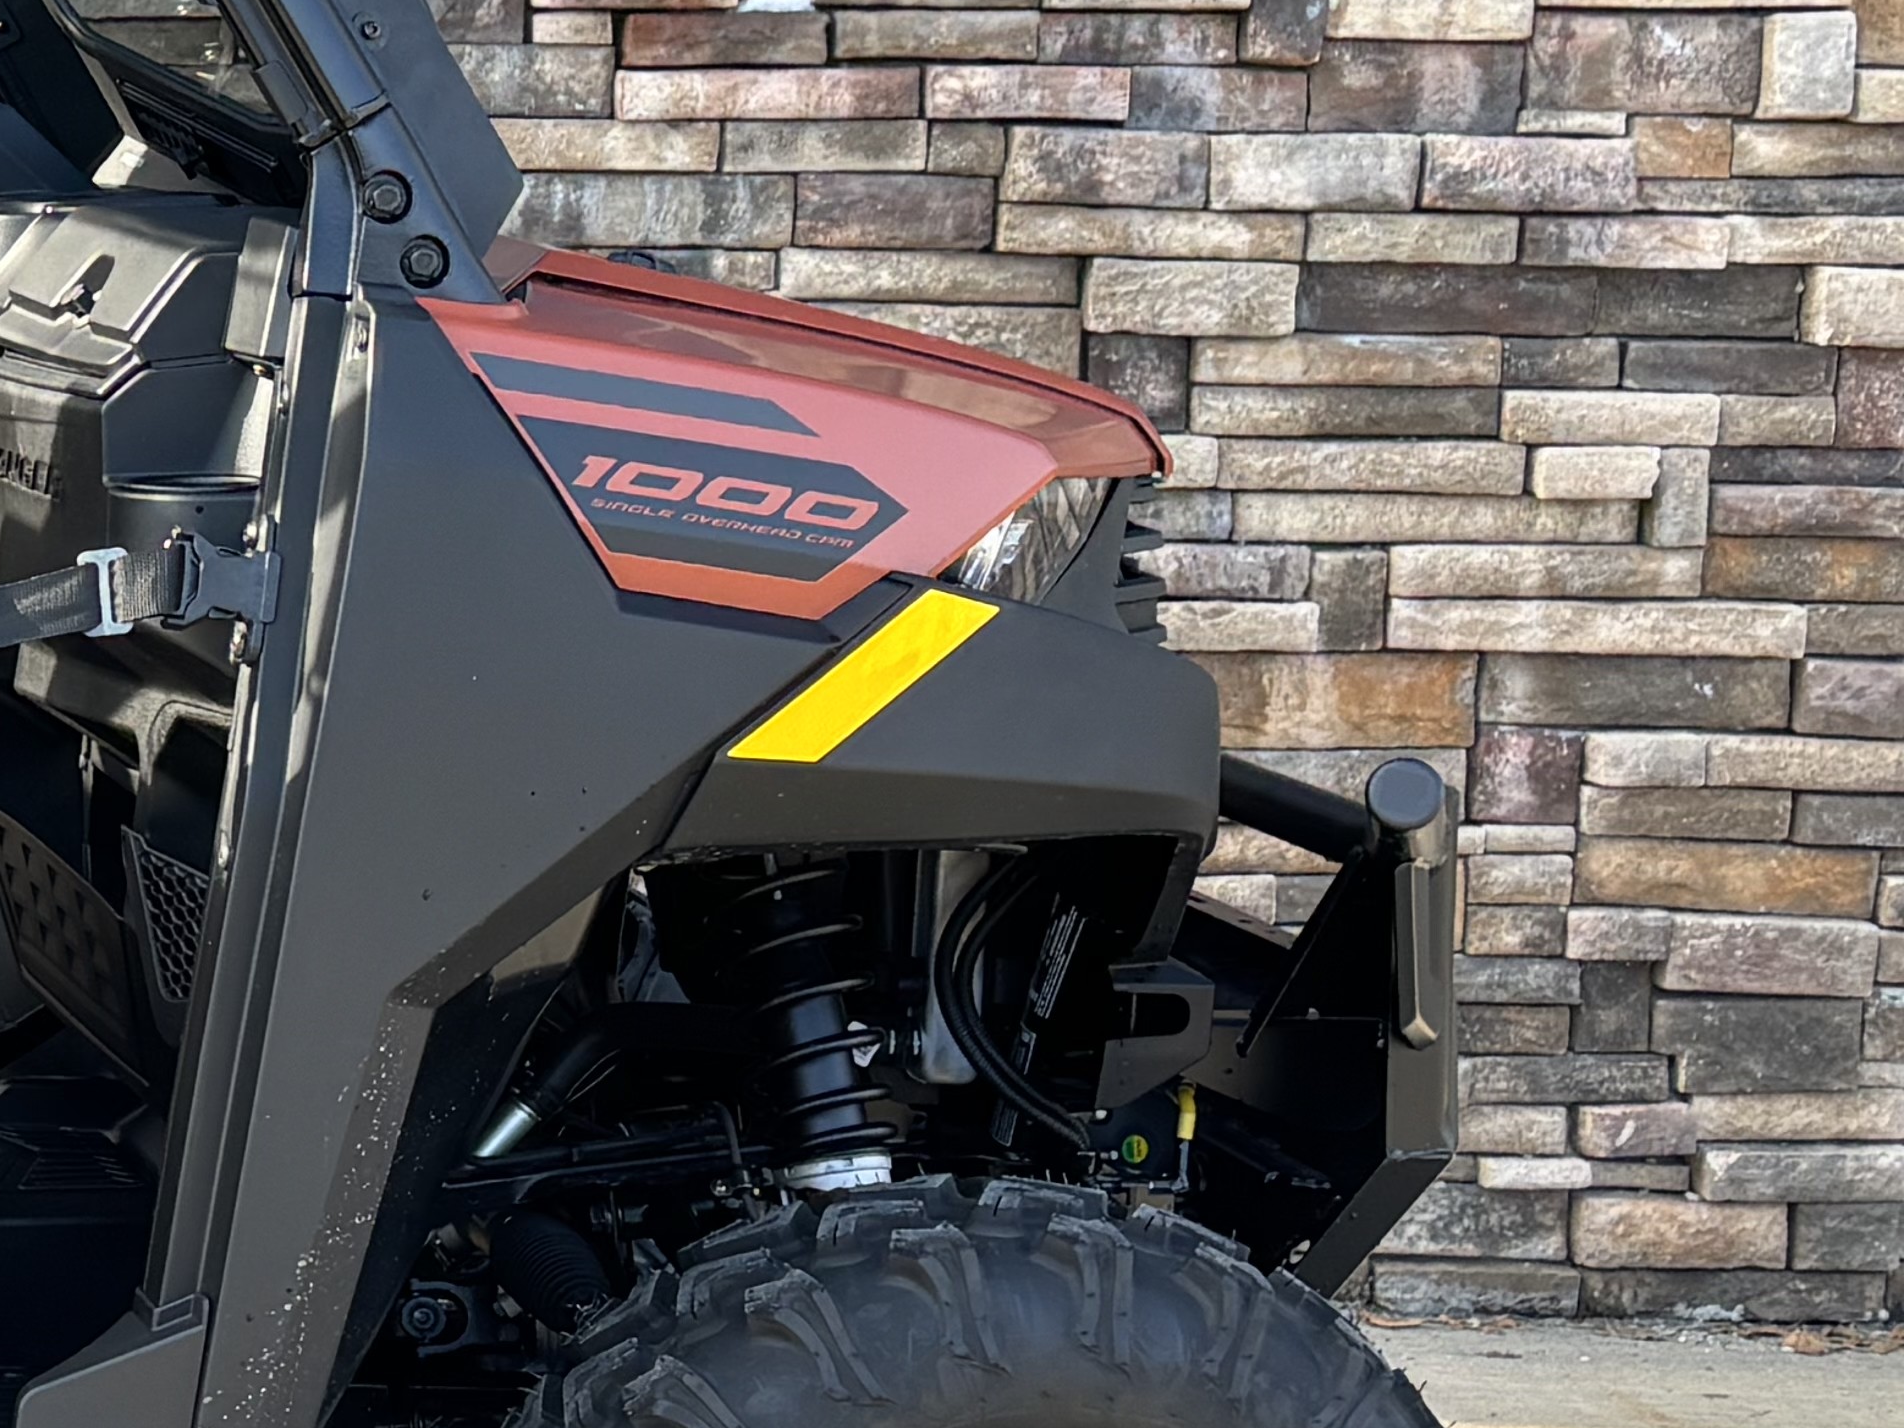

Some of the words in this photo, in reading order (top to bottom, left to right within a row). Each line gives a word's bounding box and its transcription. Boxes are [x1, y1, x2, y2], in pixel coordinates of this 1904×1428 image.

[571, 455, 879, 531] 1000
[590, 498, 675, 519] SINGLE
[681, 512, 802, 541] OVERHEAD
[805, 533, 855, 549] CAM
